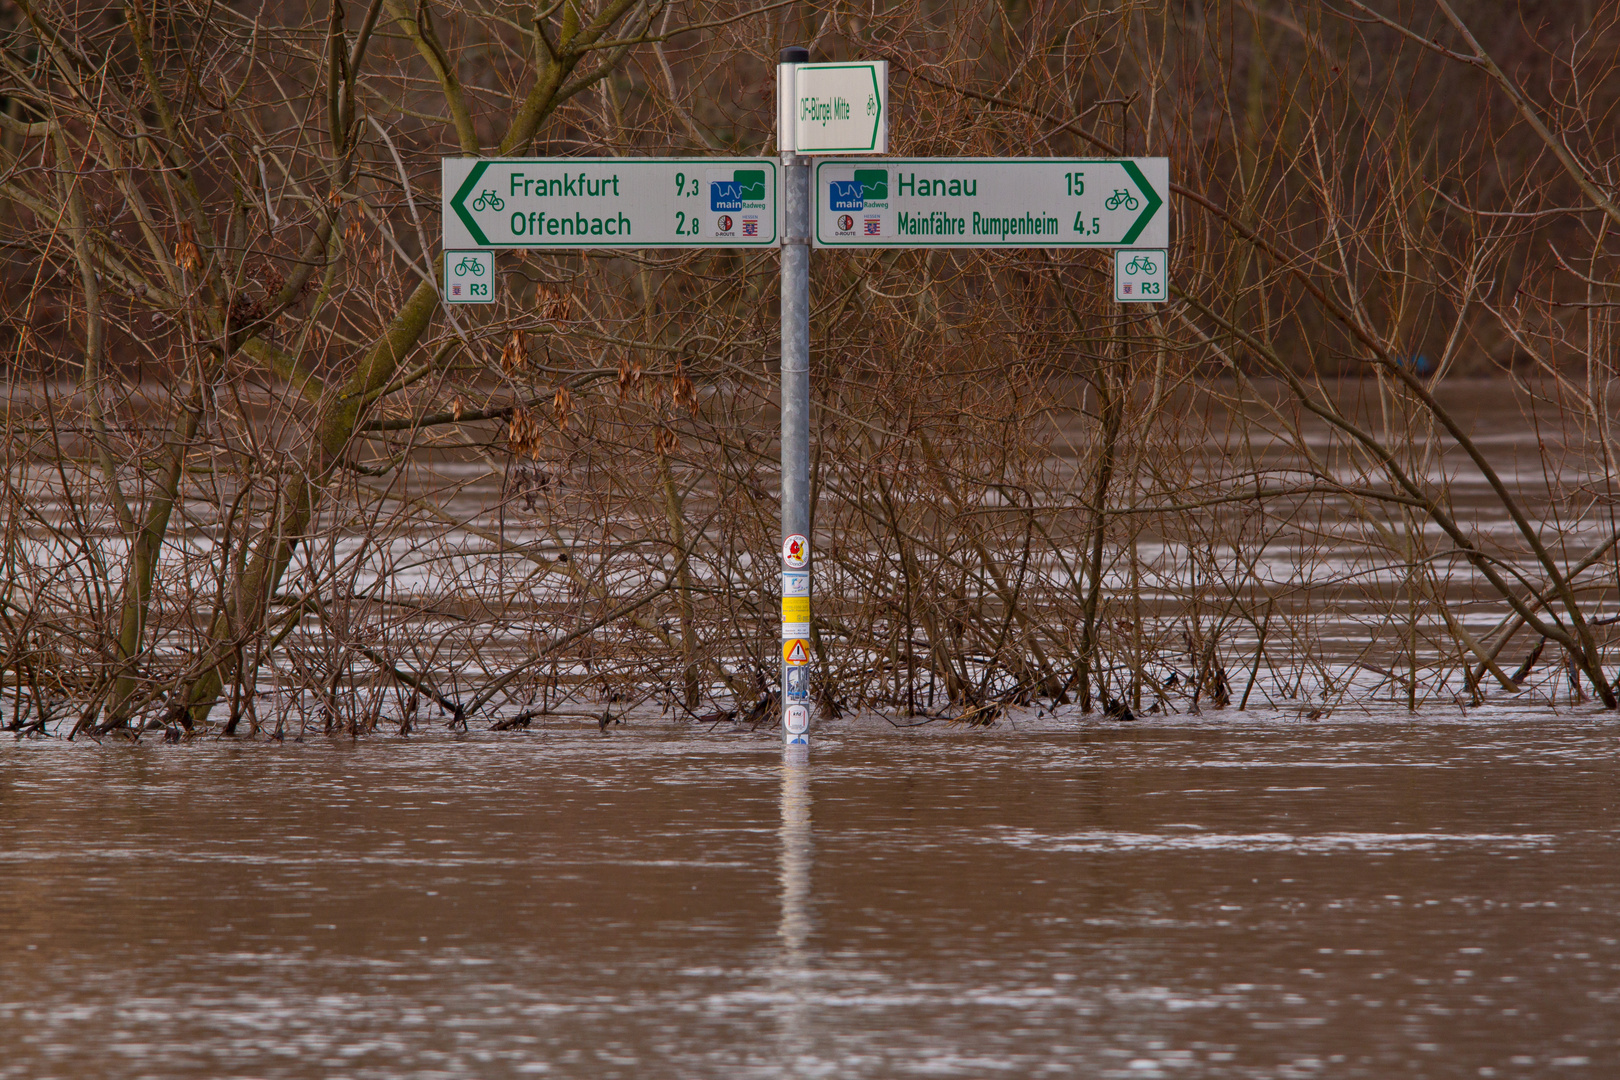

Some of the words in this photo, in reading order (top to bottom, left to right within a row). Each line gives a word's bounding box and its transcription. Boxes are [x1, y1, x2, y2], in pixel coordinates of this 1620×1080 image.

[800, 97, 832, 127] OF-Bürgel
[834, 97, 850, 120] Mitte
[510, 173, 619, 197] Frankfurt
[675, 172, 699, 198] 9,3
[898, 173, 977, 197] Hanau
[1064, 172, 1085, 196] 15
[716, 199, 742, 209] main
[742, 202, 766, 210] Radweg
[836, 199, 862, 208] main
[863, 201, 889, 210] Radweg
[510, 211, 631, 236] Offenbach
[675, 211, 700, 237] 2,8
[898, 211, 965, 236] Mainfähre
[973, 211, 1058, 240] Rumpenheim
[1073, 211, 1100, 236] 4,5
[470, 283, 488, 296] R3
[1141, 282, 1160, 294] R3
